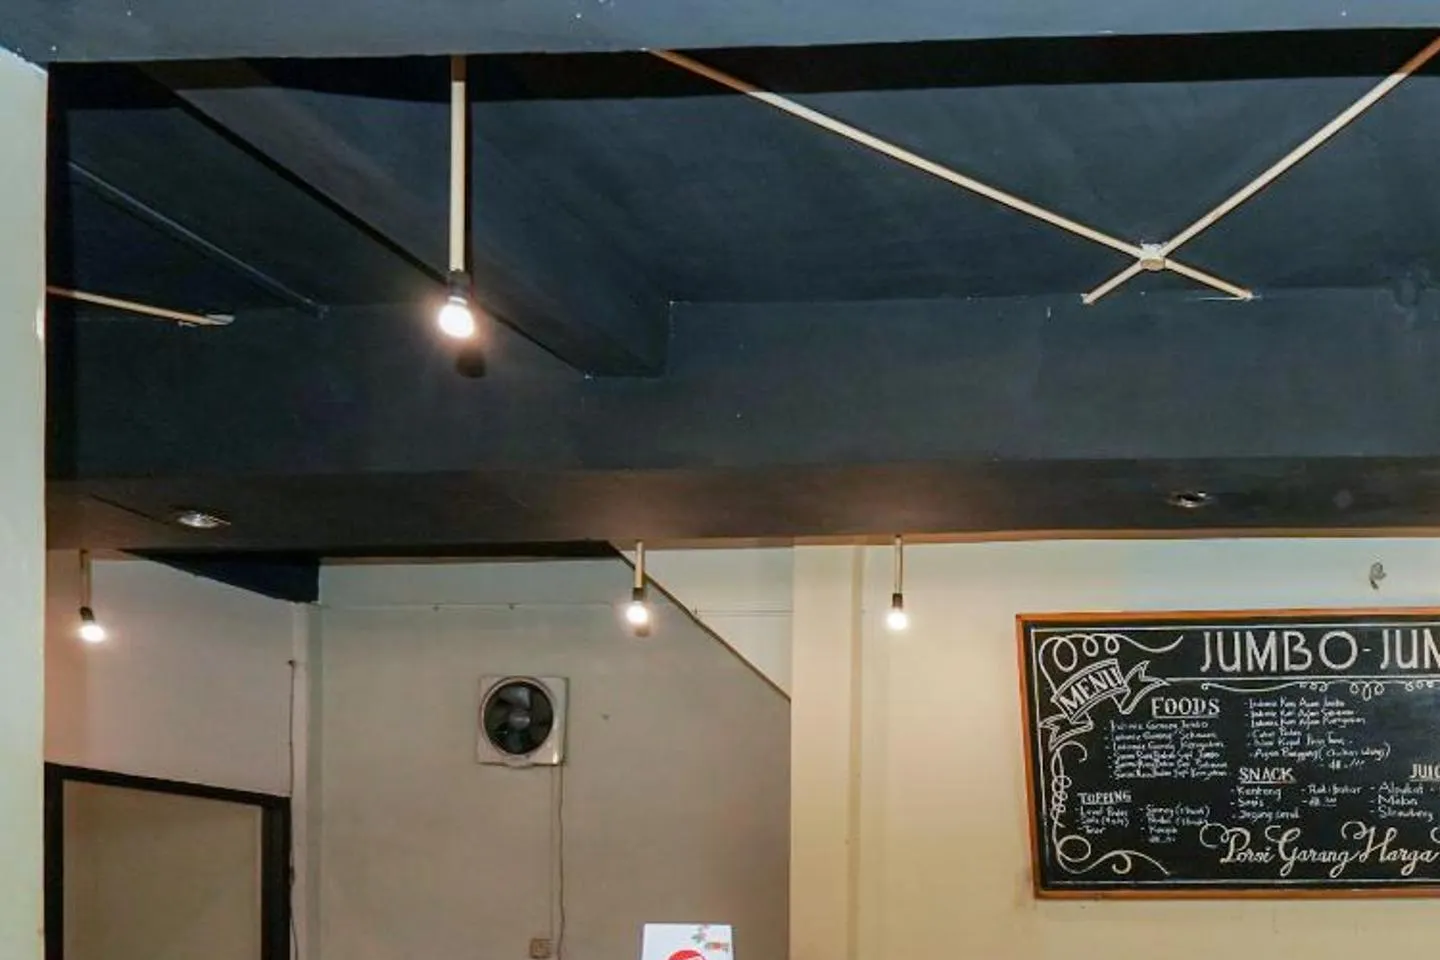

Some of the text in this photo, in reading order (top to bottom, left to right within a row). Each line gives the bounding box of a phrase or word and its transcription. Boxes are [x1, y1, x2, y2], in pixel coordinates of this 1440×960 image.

[1060, 666, 1123, 715] MENU
[1151, 697, 1221, 716] FOODS
[1239, 766, 1295, 781] SNACK
[1378, 794, 1418, 806] Melon
[1202, 824, 1275, 864] Porsi
[1265, 826, 1357, 878] Garang
[1342, 822, 1440, 876] Harga
